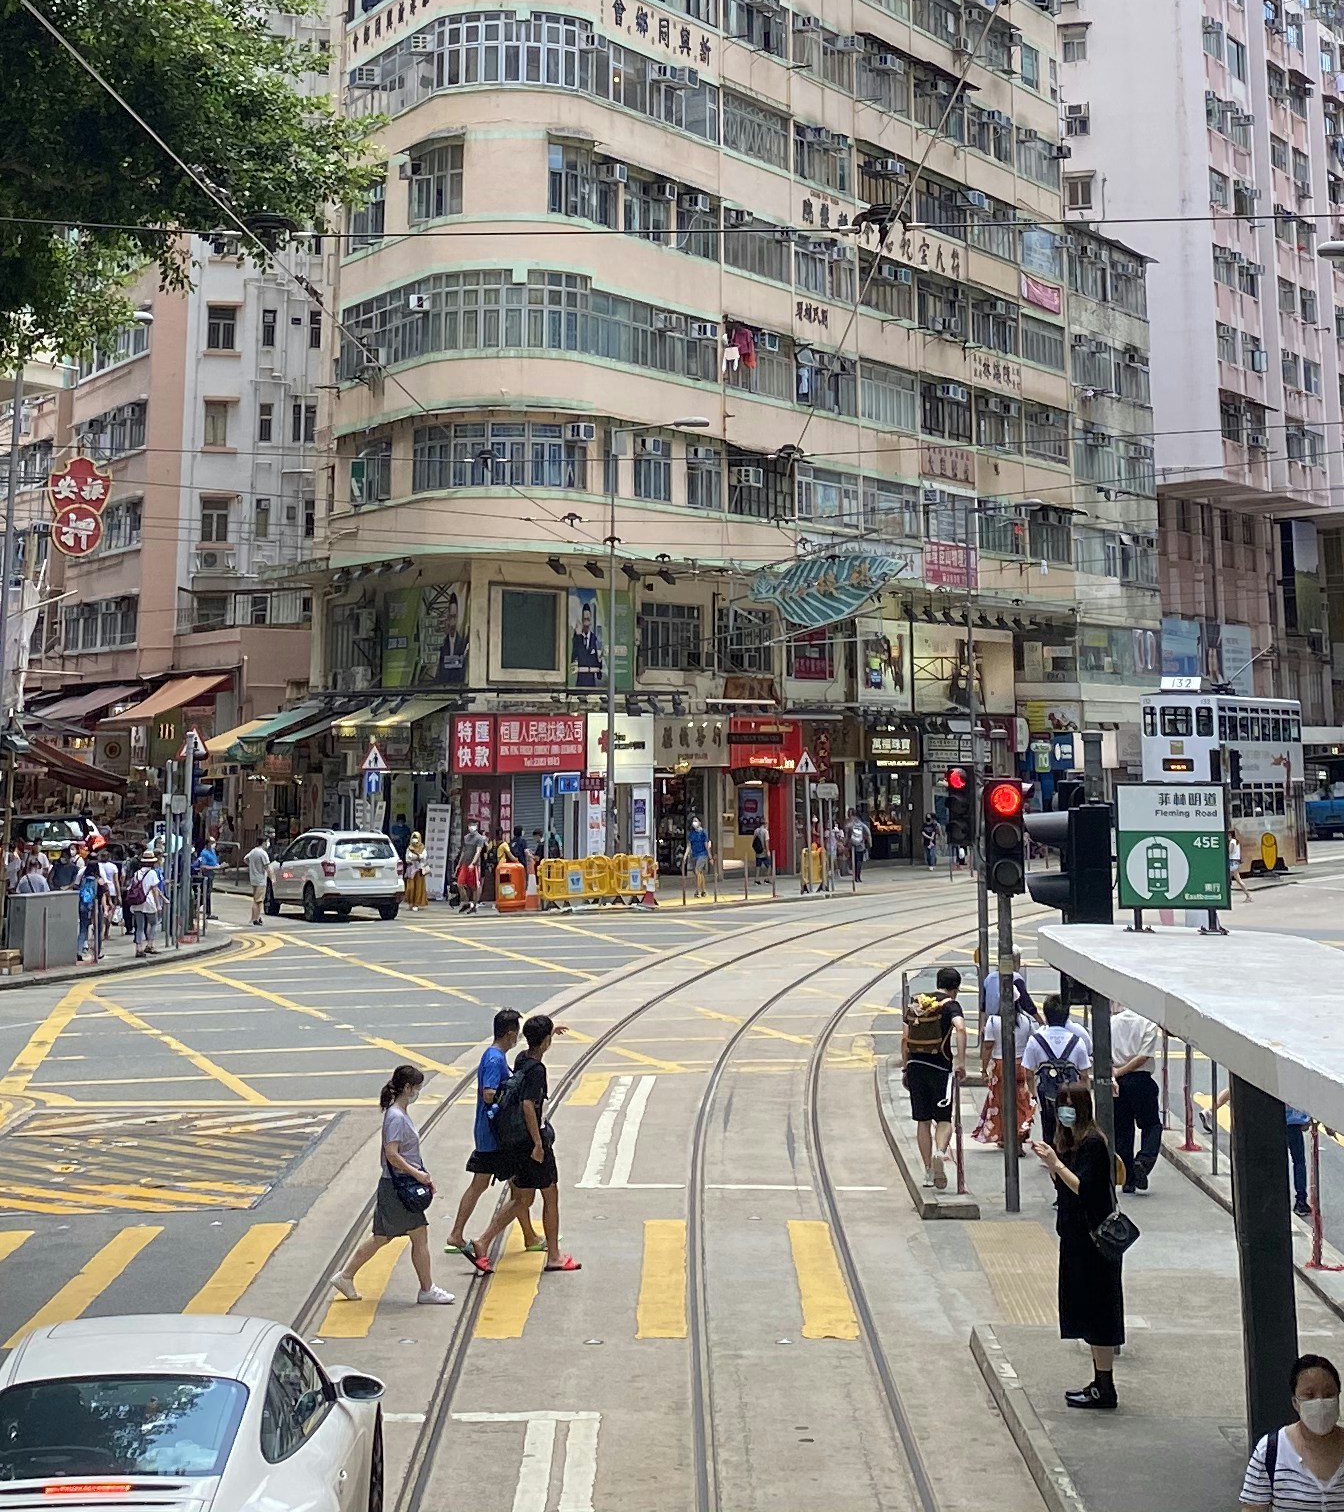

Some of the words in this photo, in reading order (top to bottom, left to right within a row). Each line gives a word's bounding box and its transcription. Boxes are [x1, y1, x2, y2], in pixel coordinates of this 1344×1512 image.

[61, 513, 96, 551] 押
[1170, 678, 1192, 688] 132
[1158, 792, 1218, 807] 菲林明道
[1155, 809, 1191, 819] Fleming
[1195, 809, 1218, 818] Road
[1192, 836, 1220, 849] 45E
